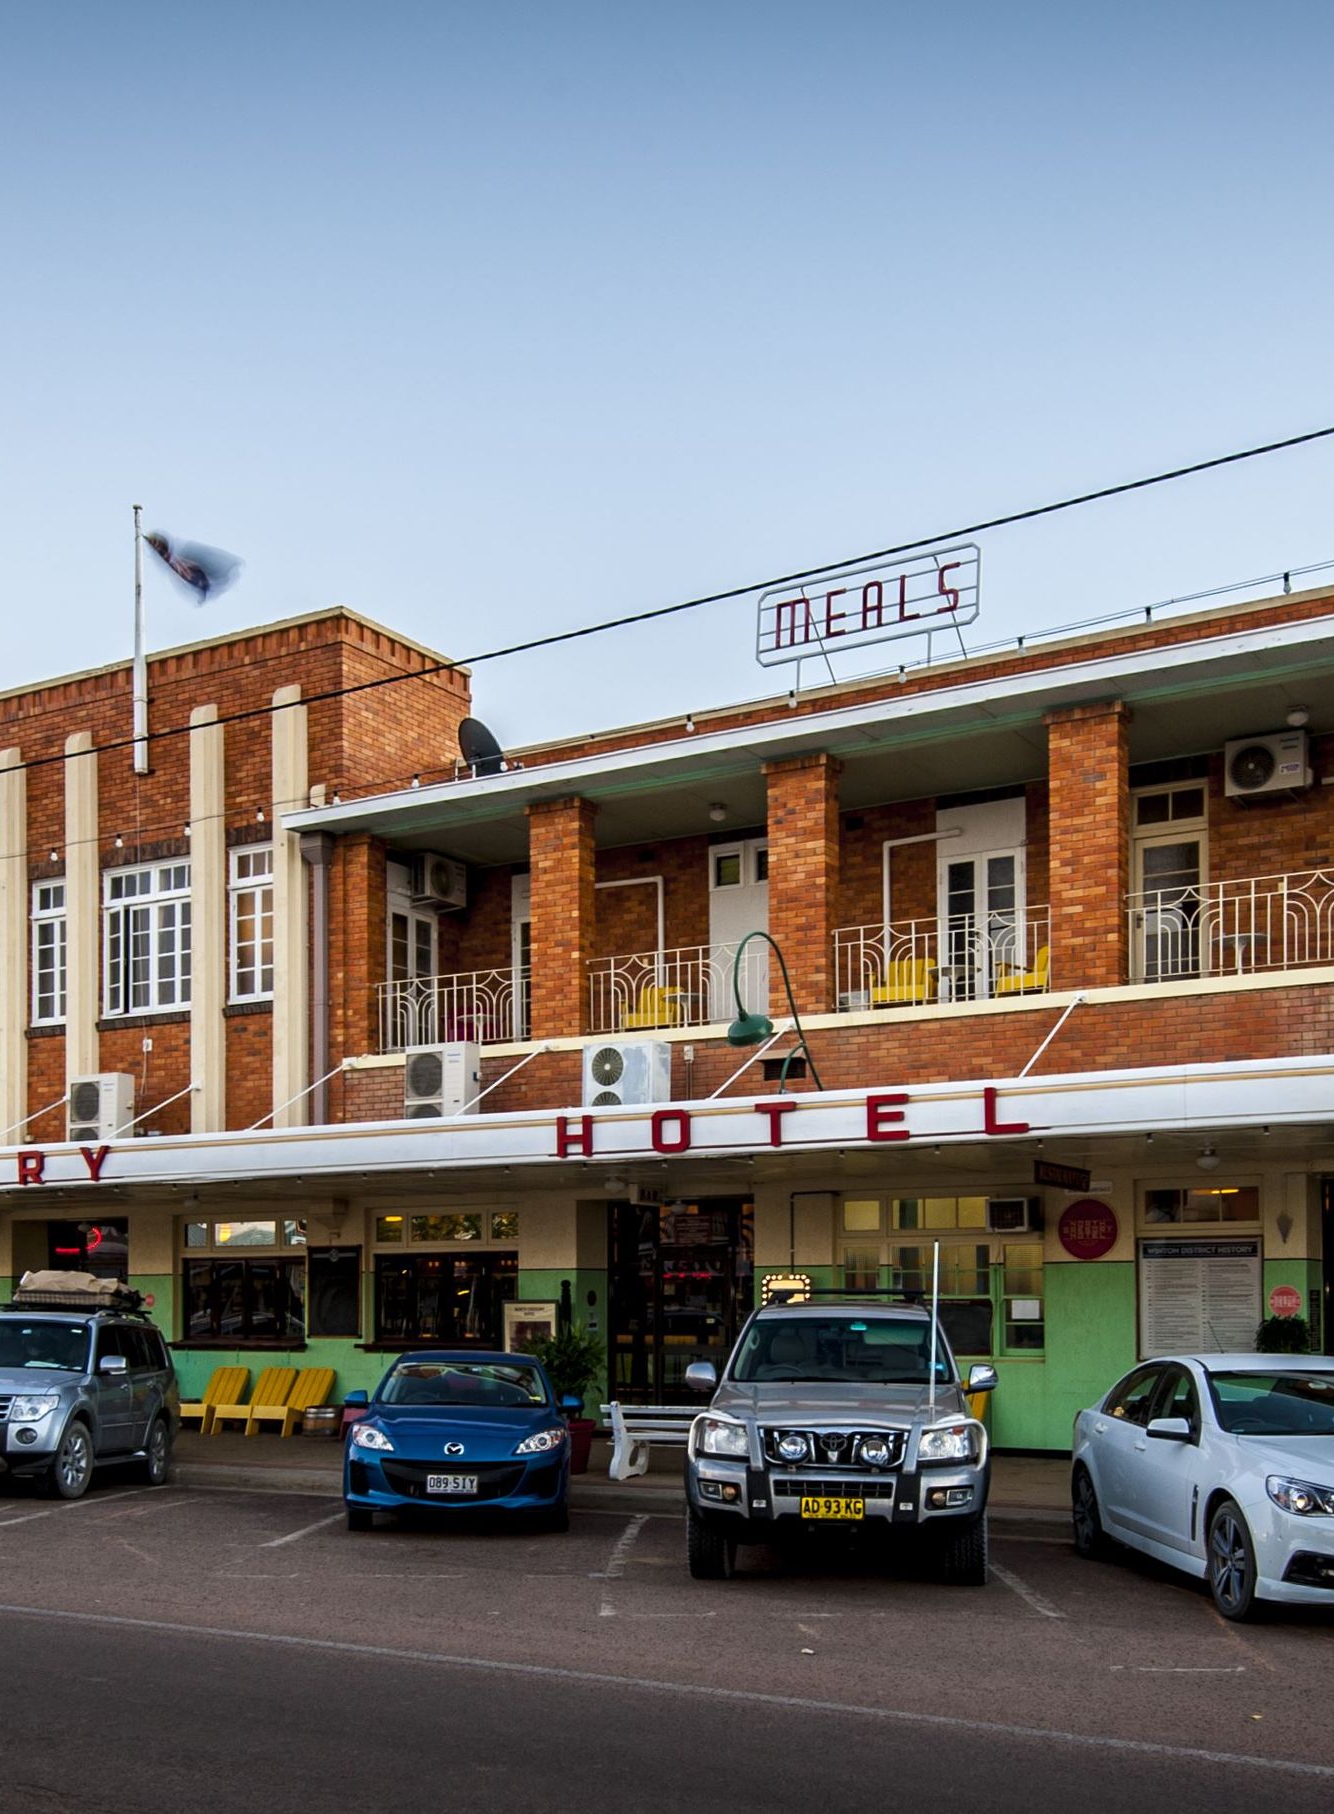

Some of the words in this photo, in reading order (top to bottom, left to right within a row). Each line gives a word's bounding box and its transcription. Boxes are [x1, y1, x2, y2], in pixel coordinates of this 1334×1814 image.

[775, 560, 962, 650] MEALS
[555, 1086, 1030, 1158] HOTEL
[1181, 1246, 1215, 1254] DISTRICT
